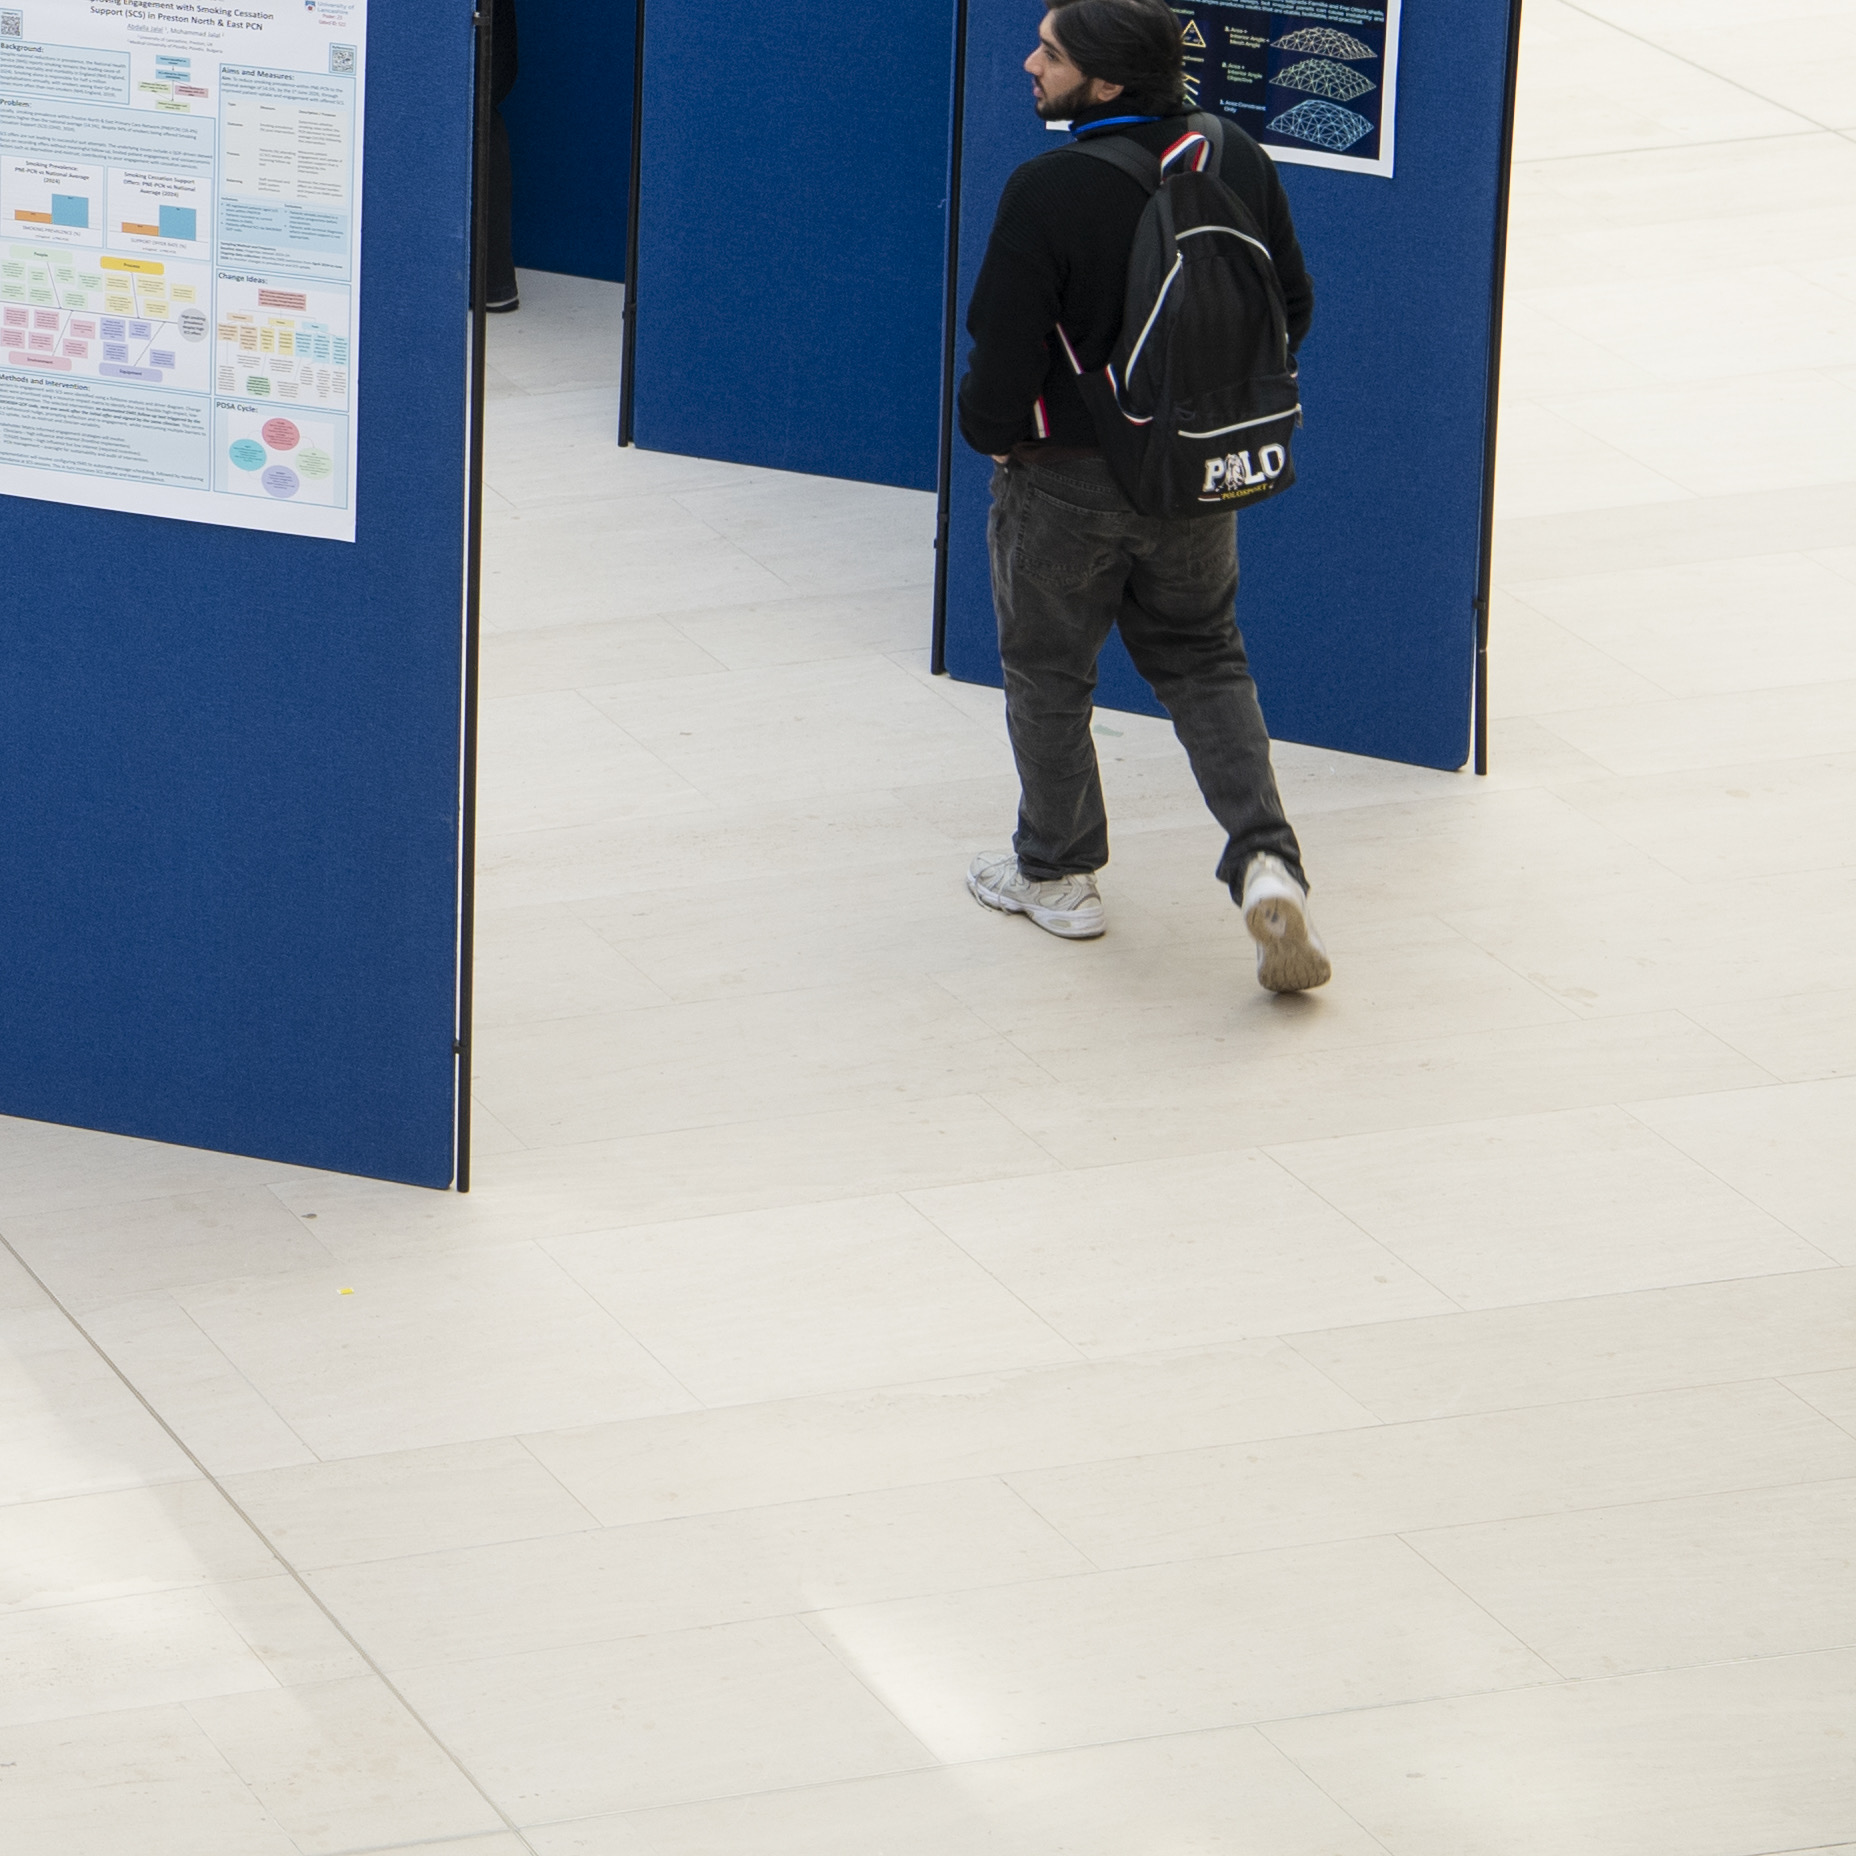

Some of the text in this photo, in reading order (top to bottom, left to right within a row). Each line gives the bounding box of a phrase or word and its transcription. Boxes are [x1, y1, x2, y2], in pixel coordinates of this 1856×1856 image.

[90, 5, 264, 31] Support (SCS) in Preston North & East PCN
[175, 1, 195, 12] with
[196, 3, 232, 18] Smoking
[234, 7, 275, 21] Cessation
[0, 41, 45, 55] Background:
[221, 66, 295, 82] Aims and Measures:
[30, 377, 44, 385] and
[45, 379, 91, 392] Intervention:
